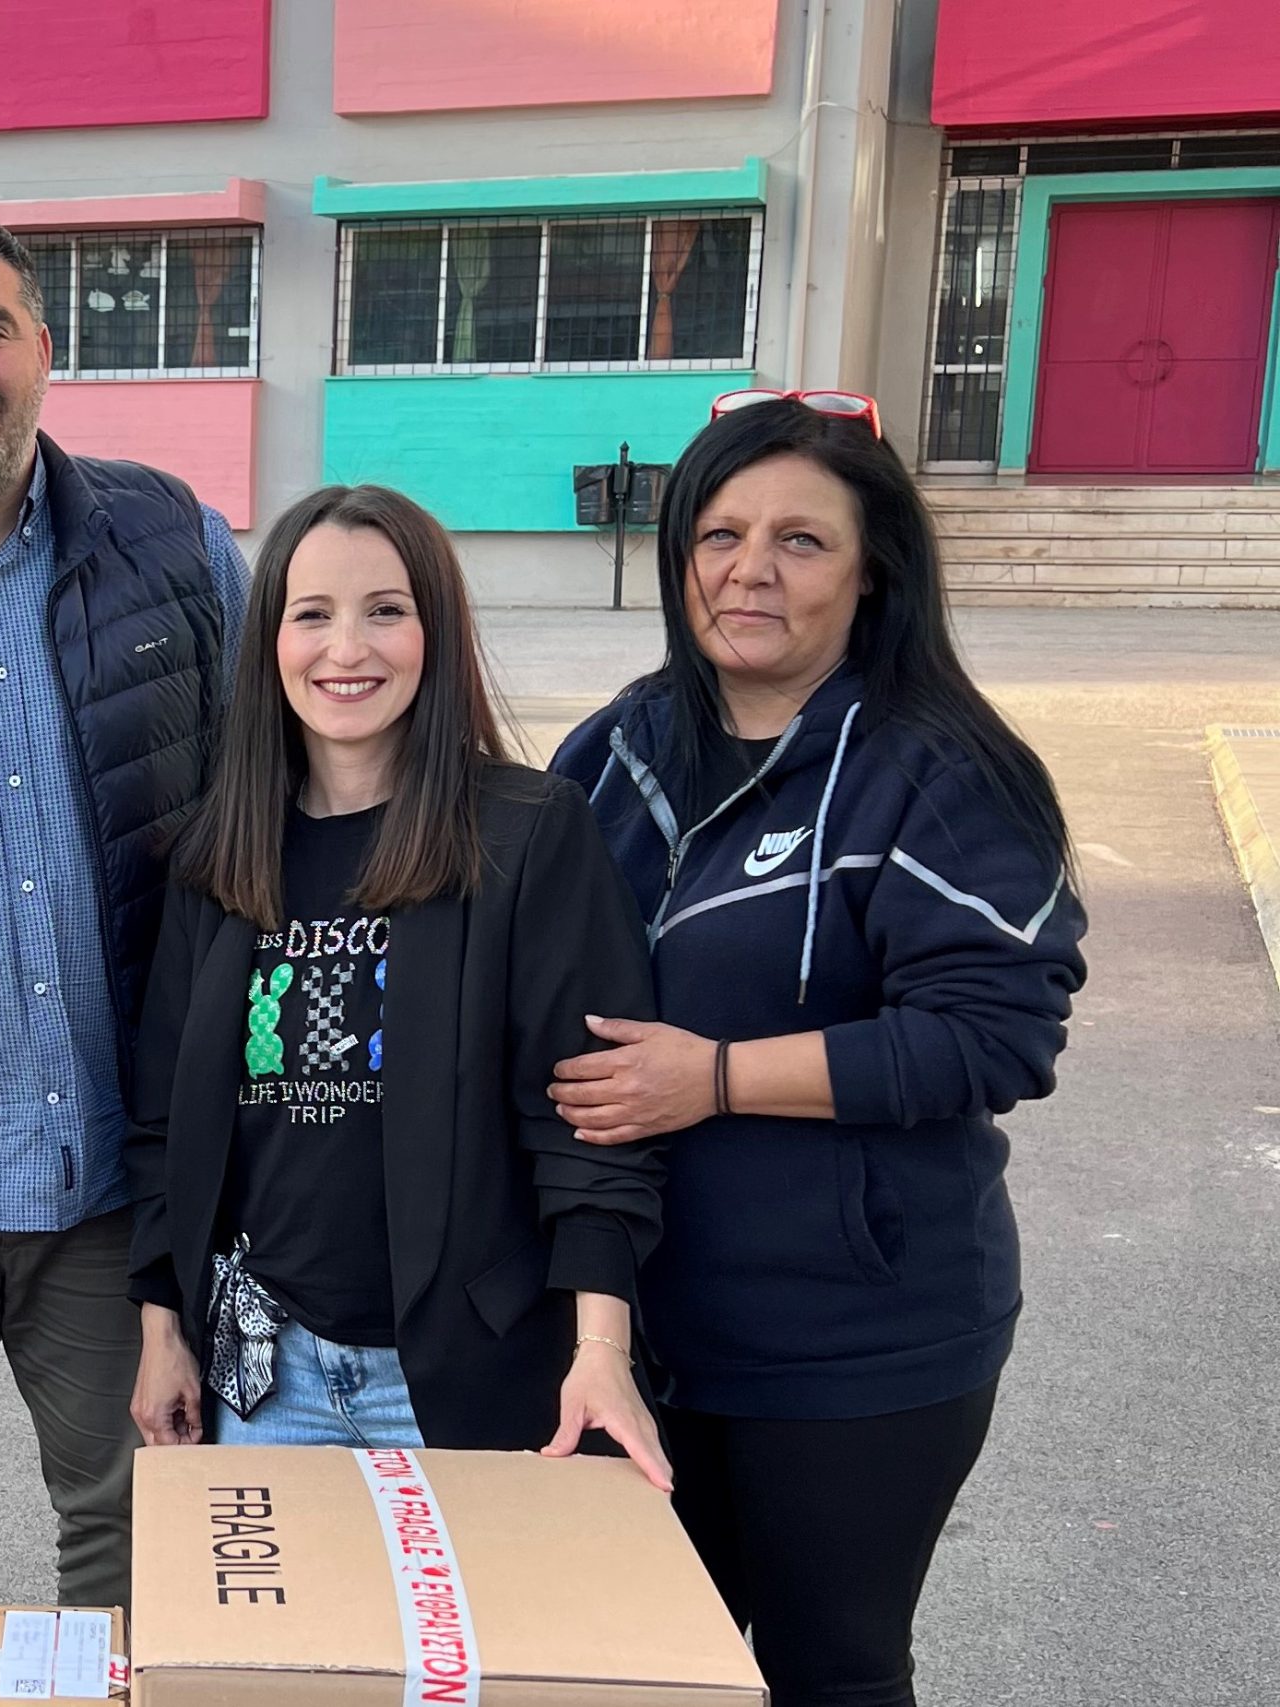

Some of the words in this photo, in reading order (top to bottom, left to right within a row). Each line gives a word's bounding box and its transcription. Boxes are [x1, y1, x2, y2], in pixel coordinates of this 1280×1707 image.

[285, 916, 391, 958] DISCO
[238, 1081, 278, 1105] LIFE
[287, 1105, 346, 1125] TRIP
[208, 1487, 287, 1605] FRAGILE
[388, 1498, 445, 1557] FRAGILE
[410, 1580, 470, 1705] ΕΥΘΡΑΥΣΤΟΝ
